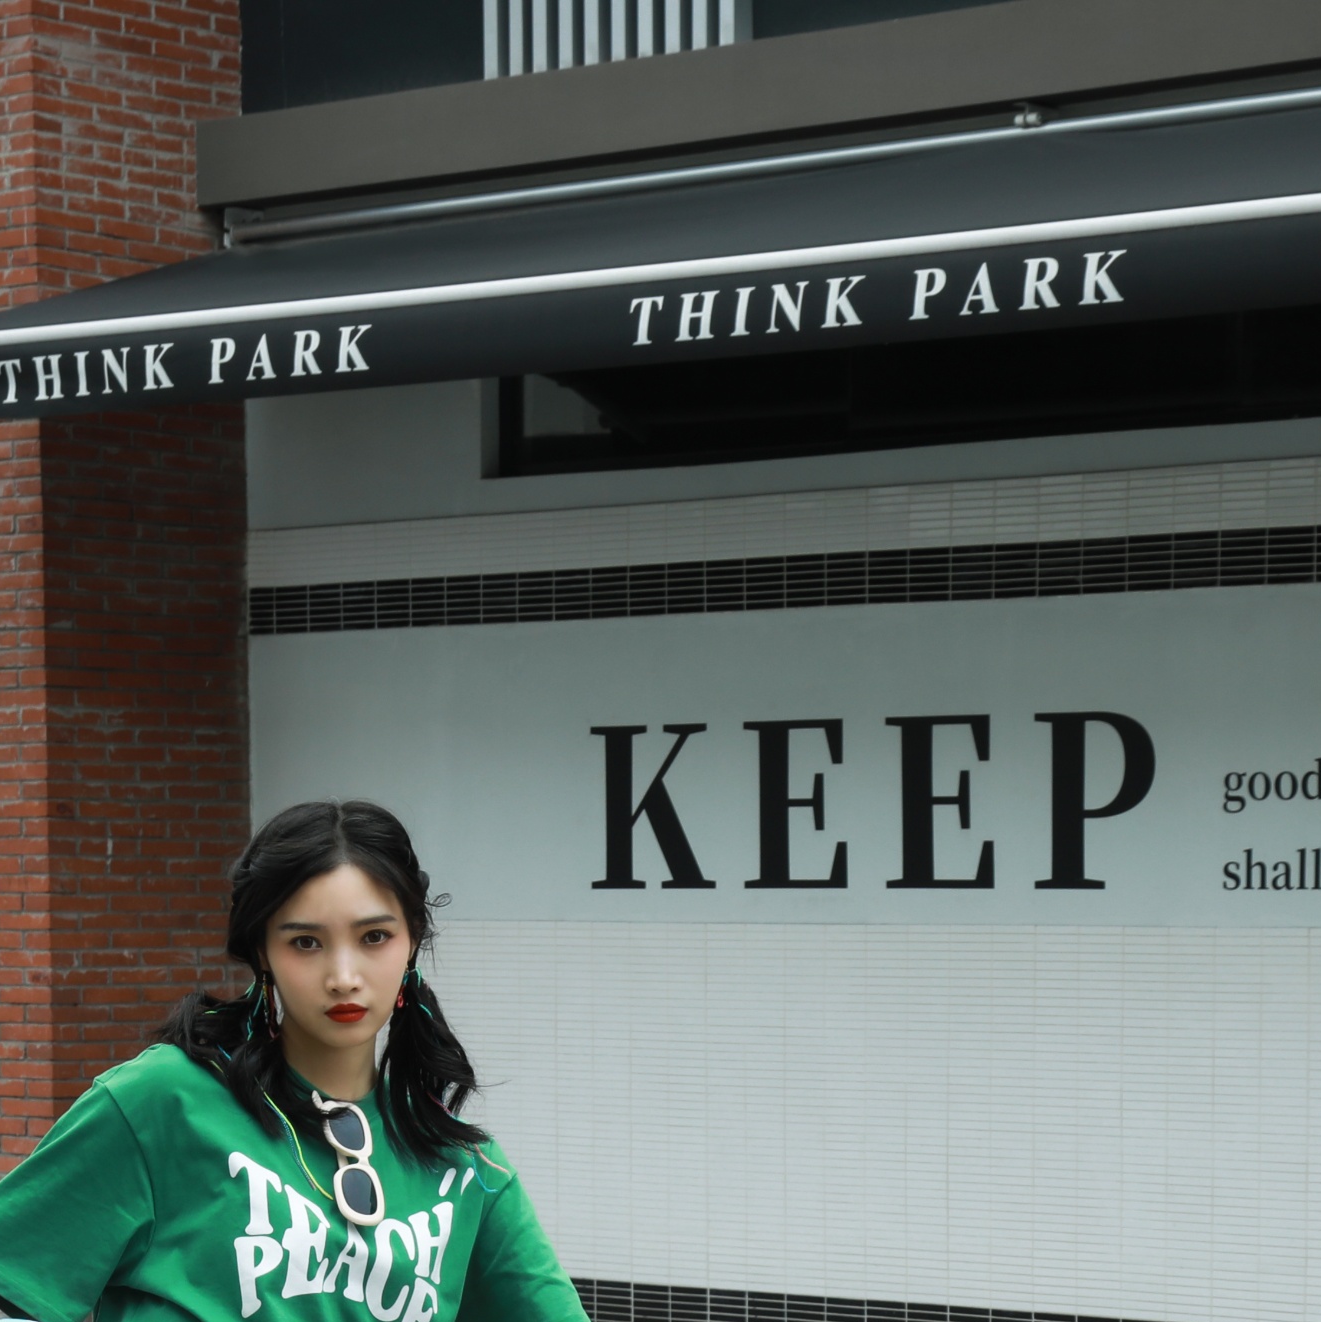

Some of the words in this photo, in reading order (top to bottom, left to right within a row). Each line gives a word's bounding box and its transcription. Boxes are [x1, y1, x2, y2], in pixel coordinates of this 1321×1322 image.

[628, 275, 867, 347] THINK
[908, 249, 1128, 320] PARK
[207, 324, 373, 385] PARK
[589, 710, 1157, 891] KEEP
